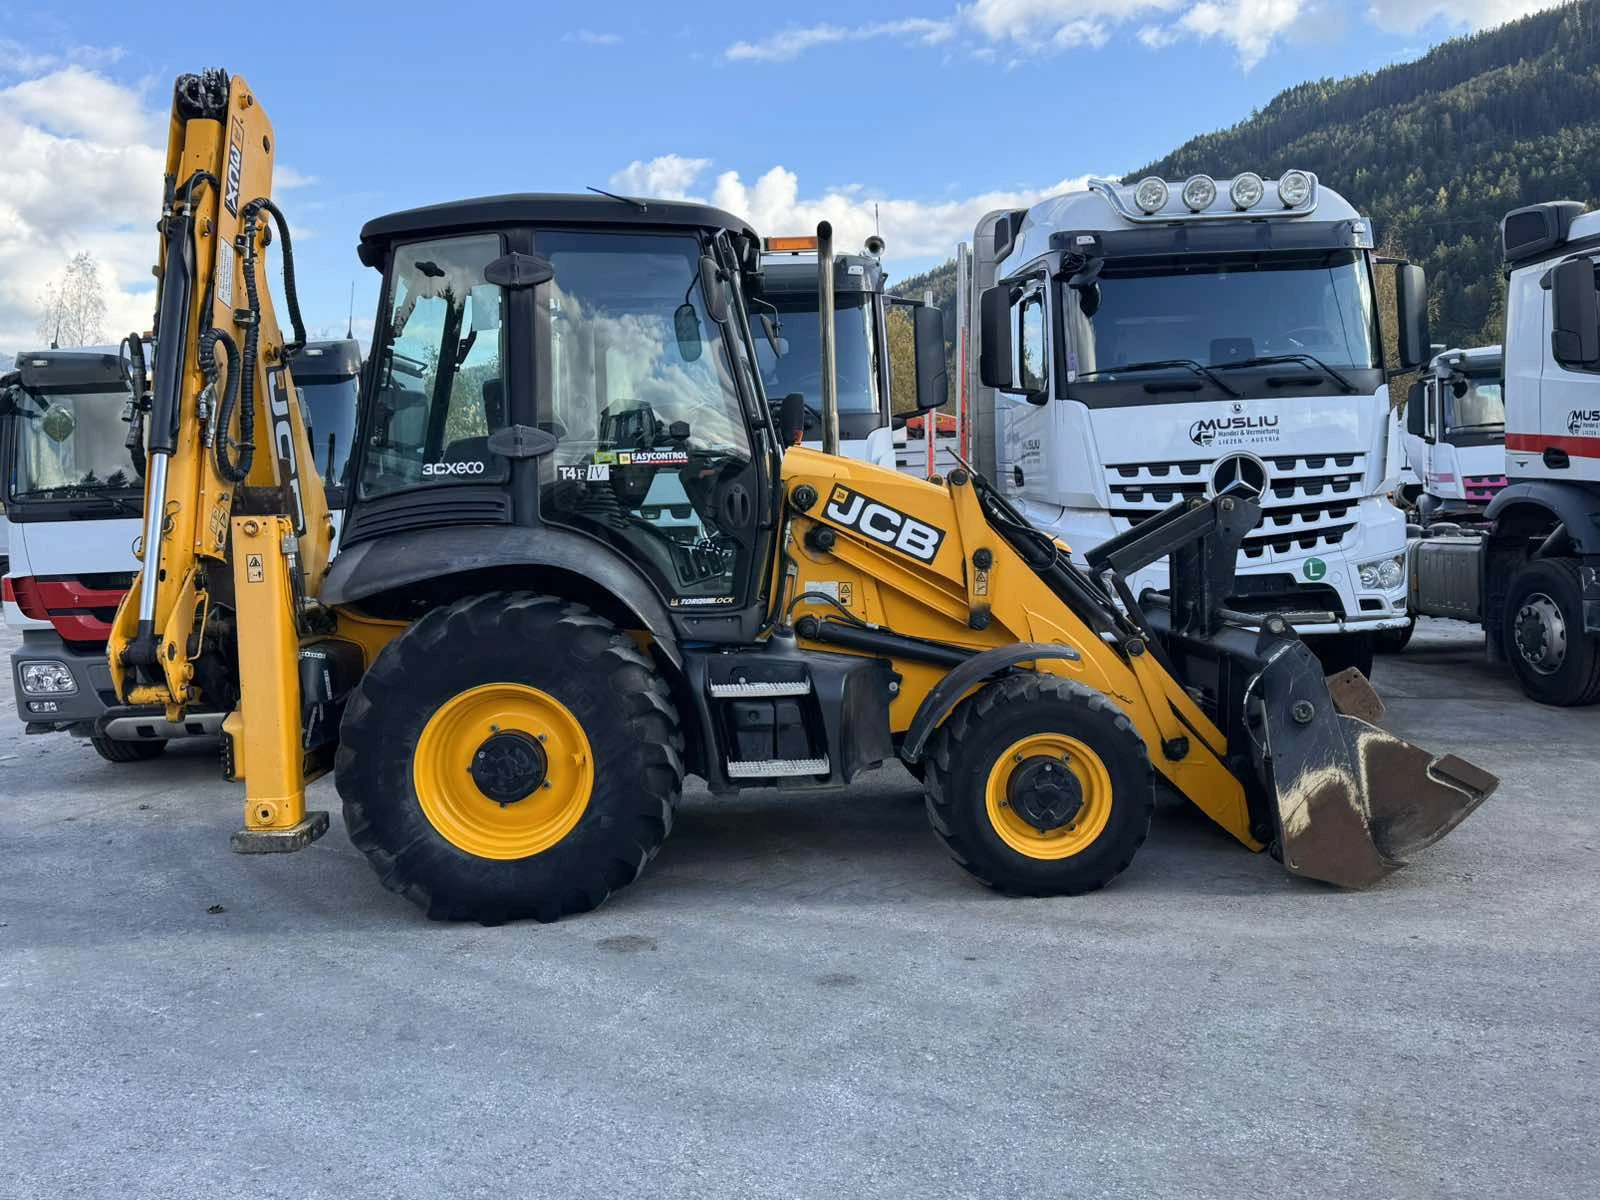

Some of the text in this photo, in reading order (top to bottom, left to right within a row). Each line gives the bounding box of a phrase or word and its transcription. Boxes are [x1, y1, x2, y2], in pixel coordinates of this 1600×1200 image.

[1197, 415, 1279, 431] MUSLIU
[631, 451, 689, 463] EASYCONTROL
[827, 496, 939, 560] JCB
[1309, 562, 1321, 577] L
